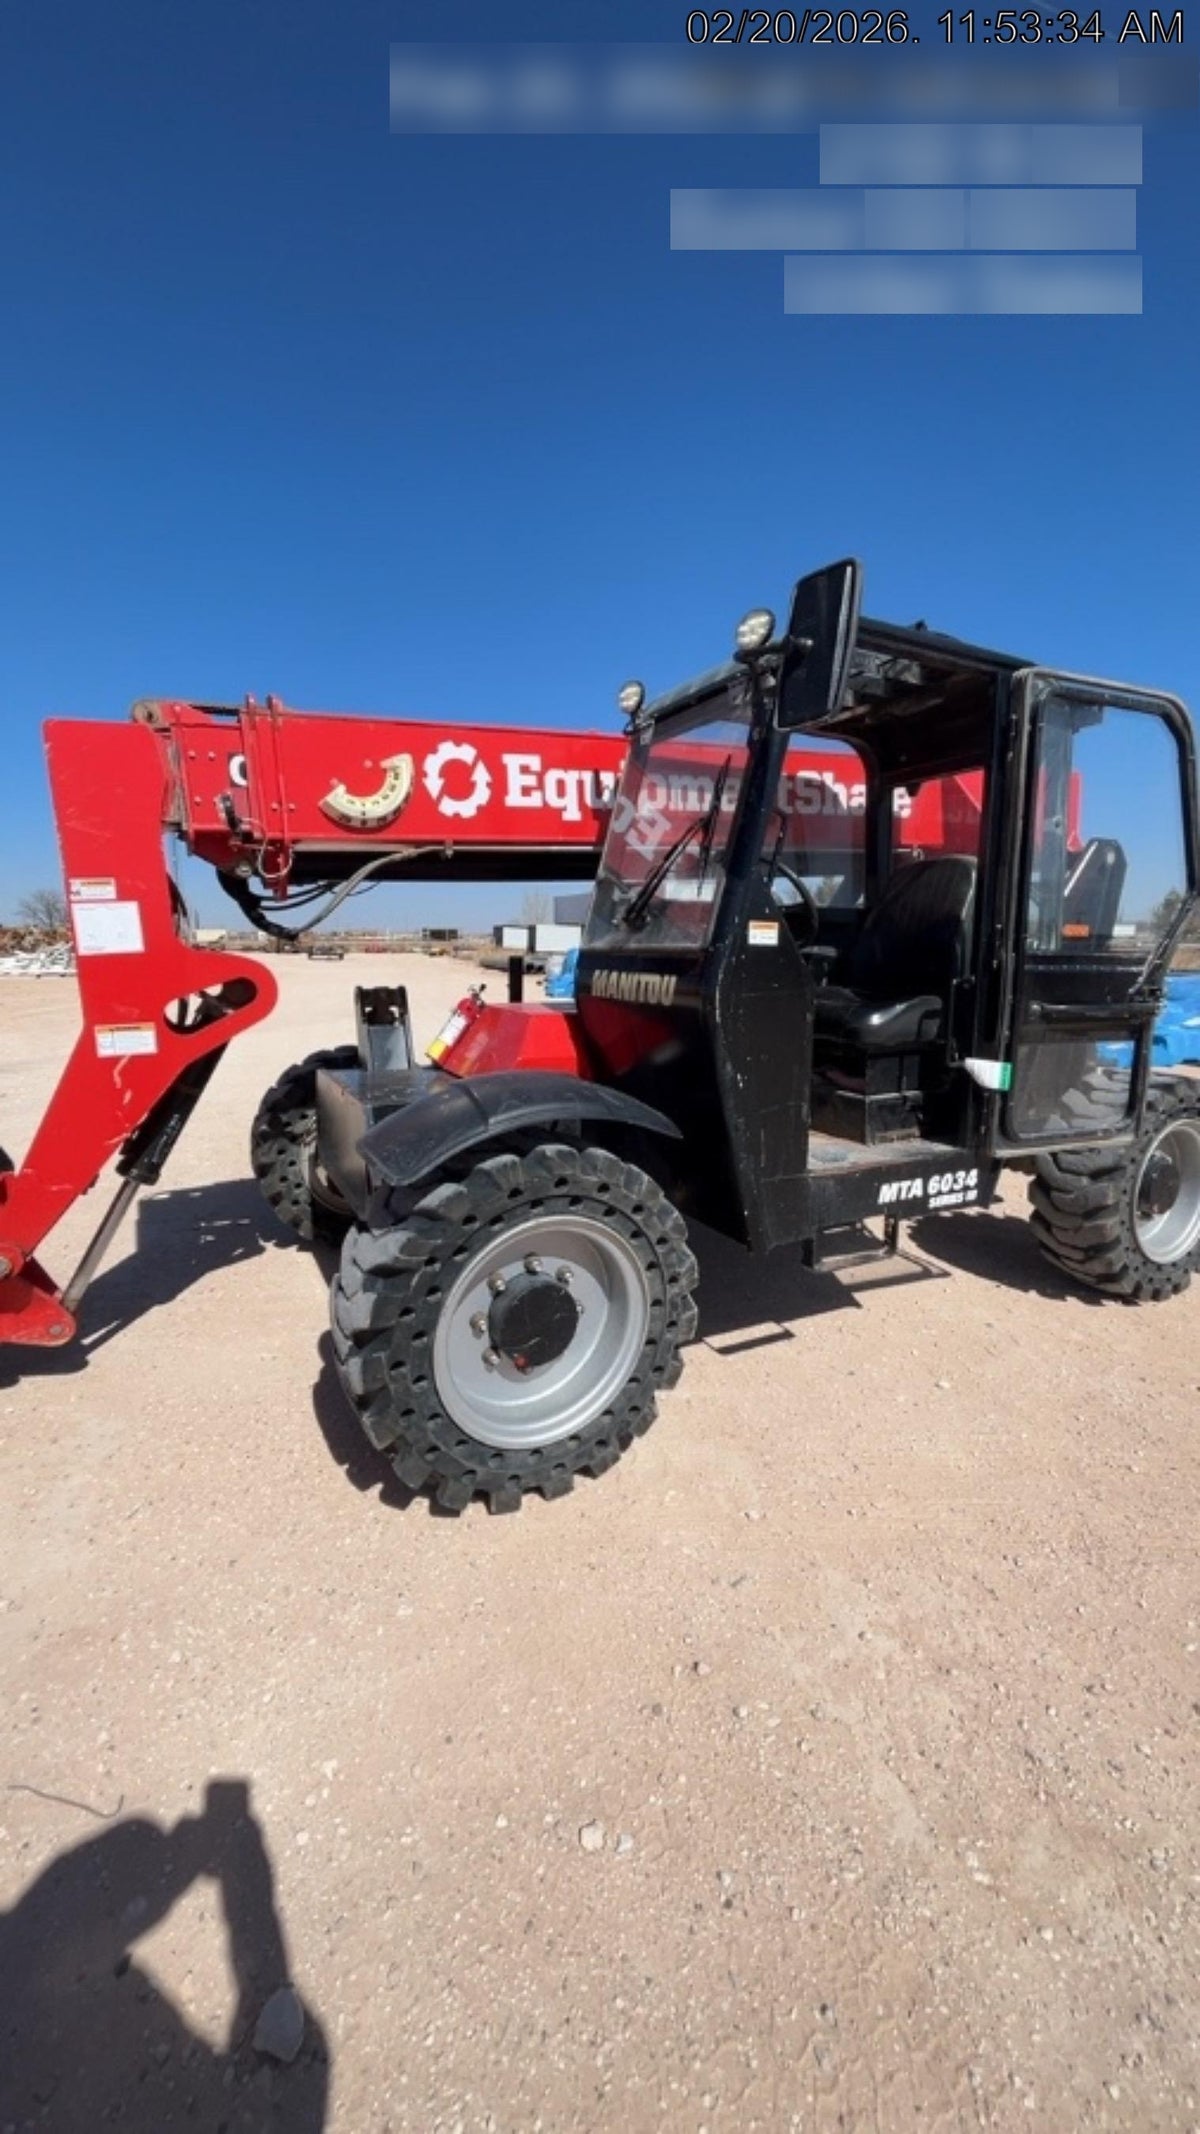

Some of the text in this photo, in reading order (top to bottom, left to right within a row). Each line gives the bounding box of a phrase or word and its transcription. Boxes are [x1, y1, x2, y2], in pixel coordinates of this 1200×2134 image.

[502, 753, 912, 821] EqupmetShae
[592, 969, 677, 1006] MANITOU
[877, 1168, 979, 1204] MTA 6034
